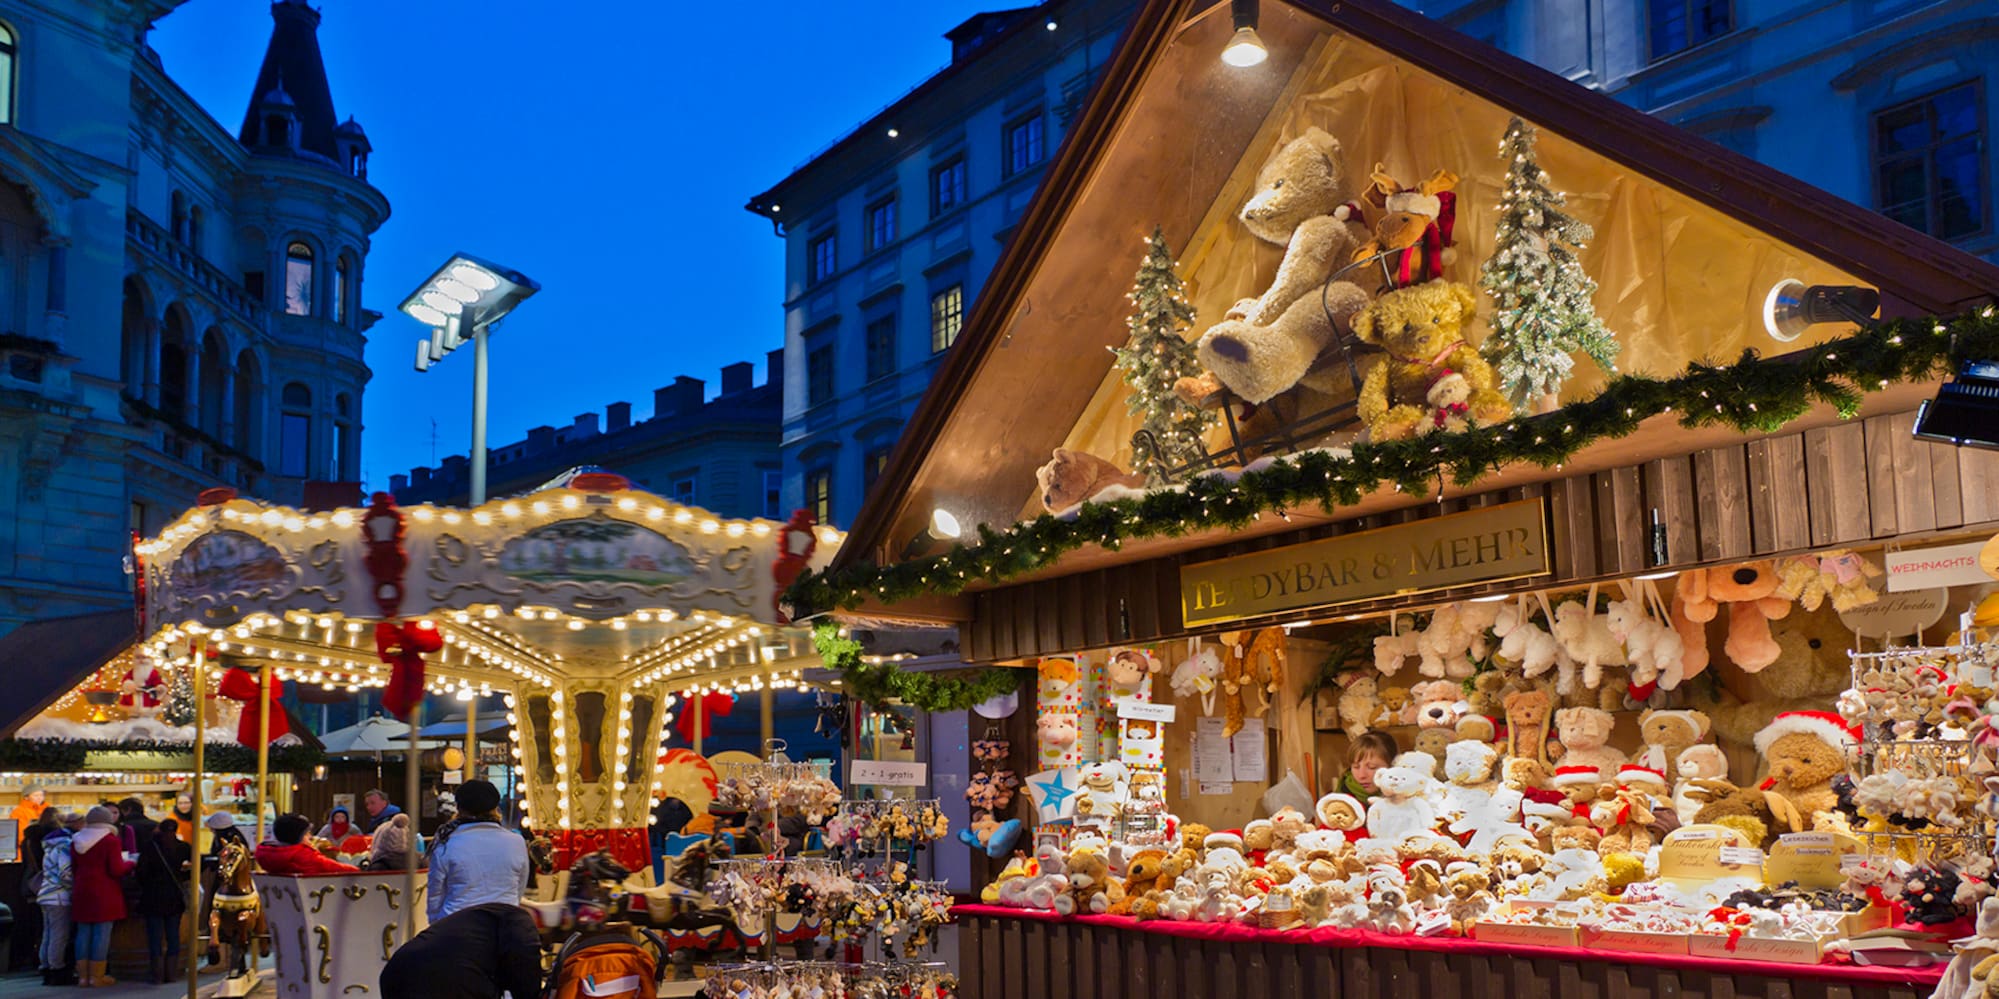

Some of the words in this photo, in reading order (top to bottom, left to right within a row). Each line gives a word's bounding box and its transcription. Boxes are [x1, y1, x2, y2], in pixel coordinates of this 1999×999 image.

[1372, 552, 1398, 580] &
[1408, 526, 1535, 576] MEHR
[1891, 556, 1976, 574] WEIHNACHTS
[861, 769, 867, 777] 2
[880, 769, 884, 777] 1
[888, 769, 914, 780] gratis
